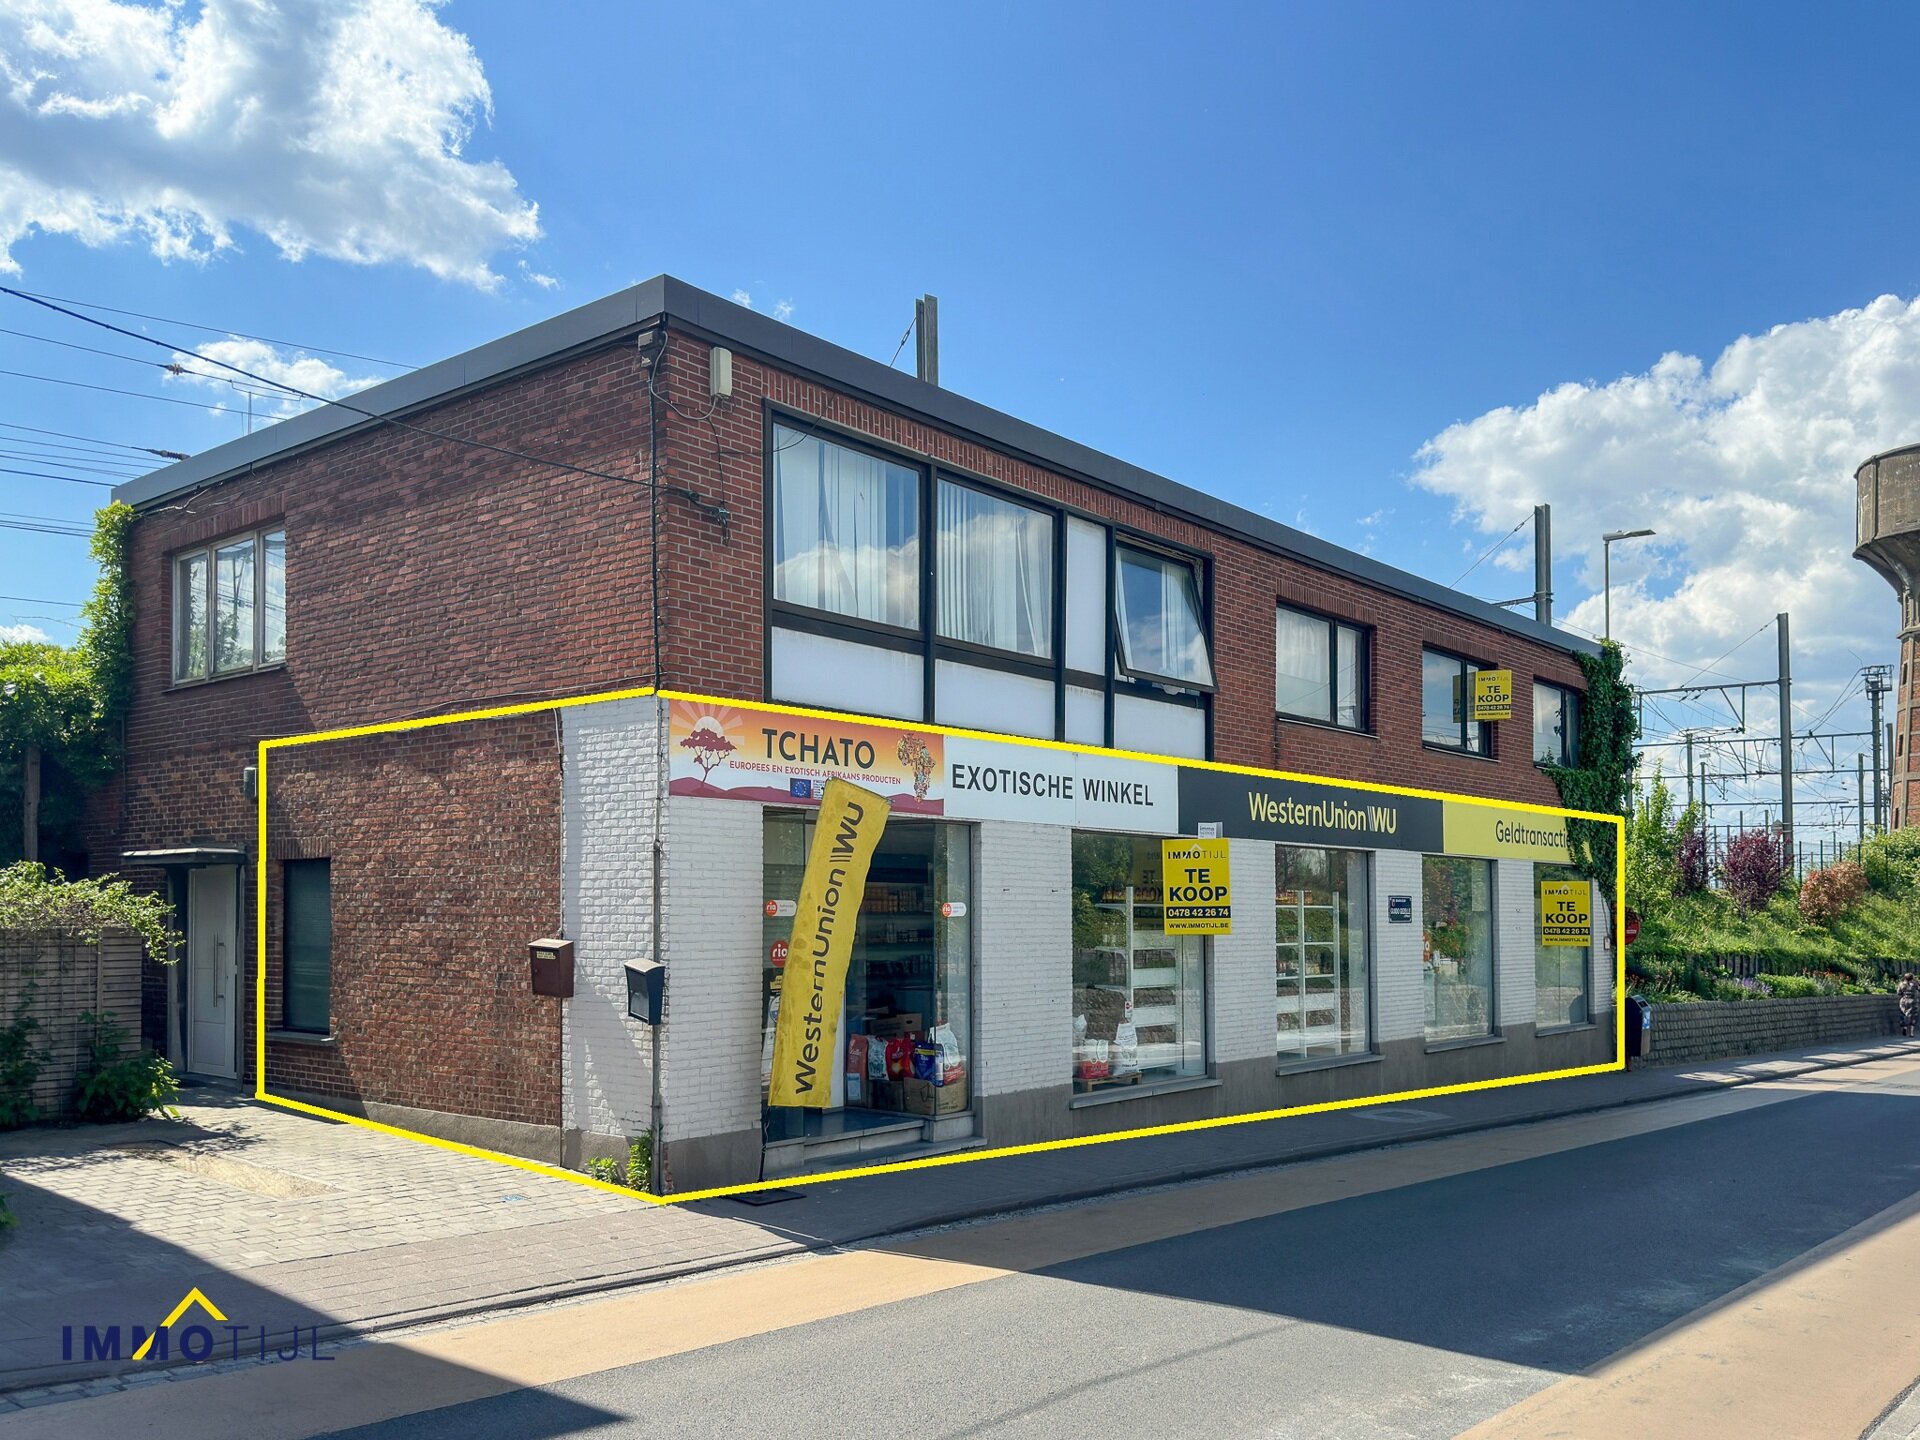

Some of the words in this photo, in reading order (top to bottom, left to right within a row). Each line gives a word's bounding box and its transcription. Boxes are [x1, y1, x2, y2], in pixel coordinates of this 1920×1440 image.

[1486, 685, 1501, 694] TE
[1478, 694, 1510, 703] KOOP
[761, 728, 875, 770] TCHATO
[729, 760, 770, 772] EUROPEES
[772, 765, 783, 773] EN
[785, 766, 820, 778] EXOTISCH
[822, 770, 861, 781] AFRIKAANS
[861, 773, 901, 785] PRODUCTEN
[952, 763, 1074, 800] EXOTISCHE
[1082, 778, 1154, 807] WINKEL
[1248, 791, 1367, 832] WesternUnion
[1184, 868, 1211, 884] TE
[1169, 886, 1228, 902] KOOP
[1168, 908, 1190, 917] 0478
[1191, 908, 1203, 917] 42
[1205, 908, 1217, 917] 26
[1218, 907, 1229, 916] 74
[1556, 901, 1576, 912] TE
[1545, 913, 1588, 924] KOOP
[795, 868, 846, 1095] WesternUnion
